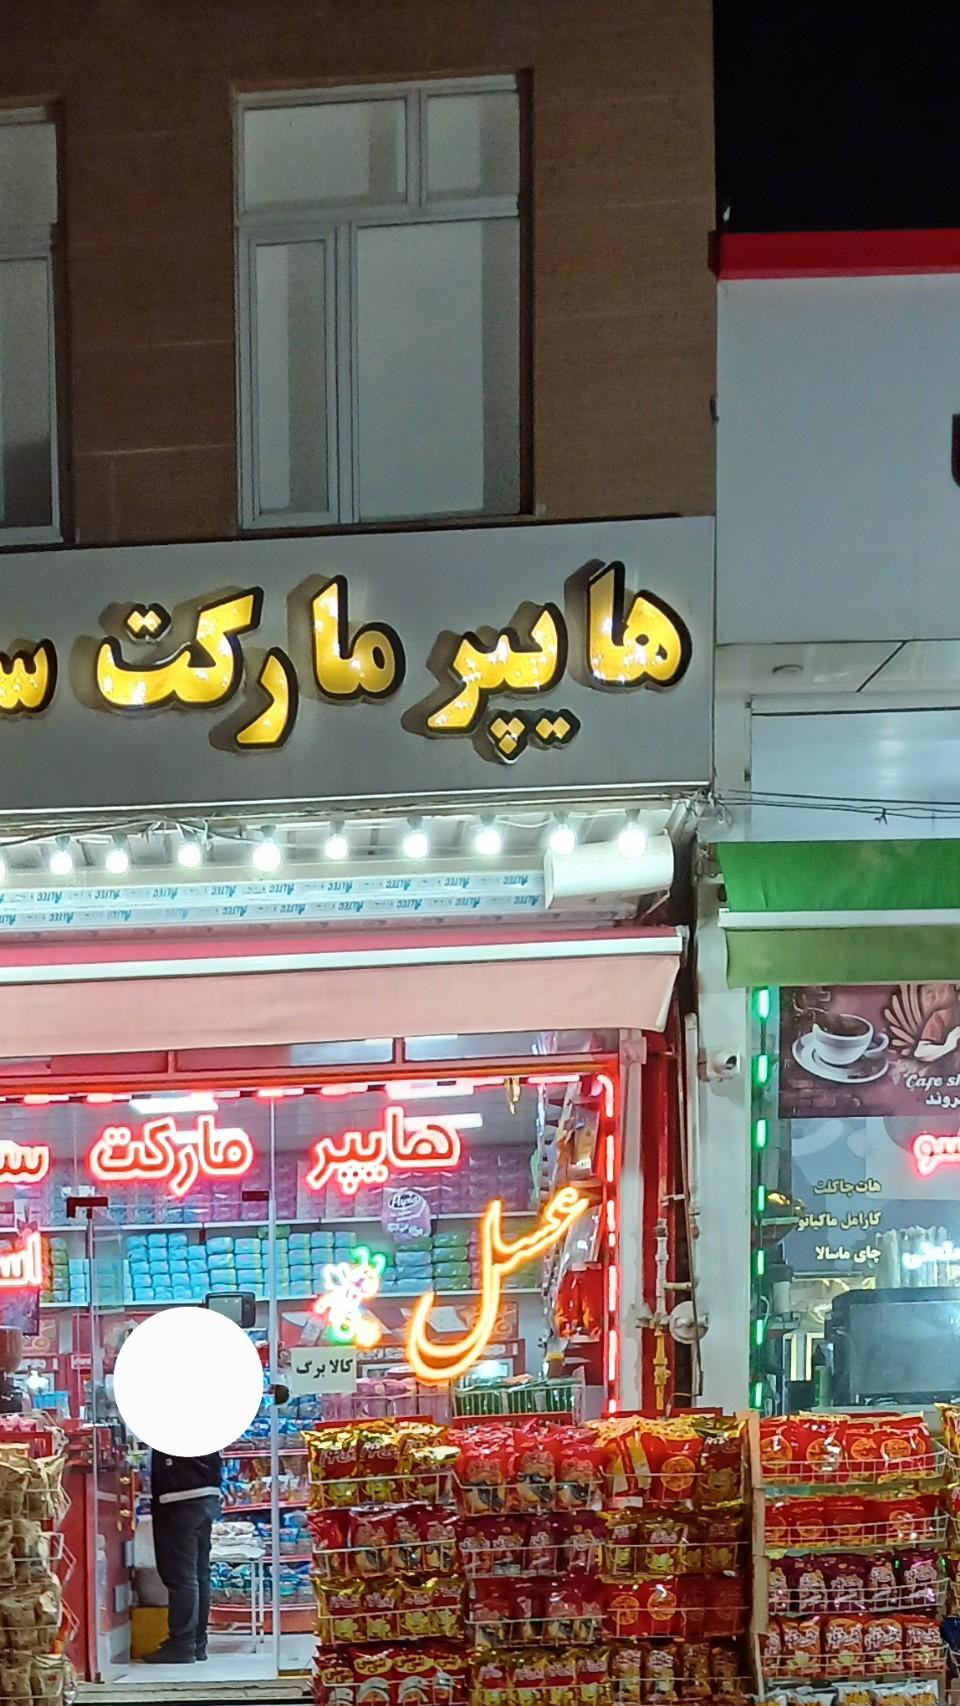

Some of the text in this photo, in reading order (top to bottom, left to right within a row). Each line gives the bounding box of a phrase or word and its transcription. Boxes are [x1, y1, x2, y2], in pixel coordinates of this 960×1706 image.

[95, 575, 405, 750] مارکت
[424, 561, 692, 763] هایپر
[90, 1115, 254, 1196] مارکت
[306, 1106, 462, 1194] هایپر
[407, 1186, 589, 1379] عسل
[815, 1245, 881, 1263] چای ماسالا
